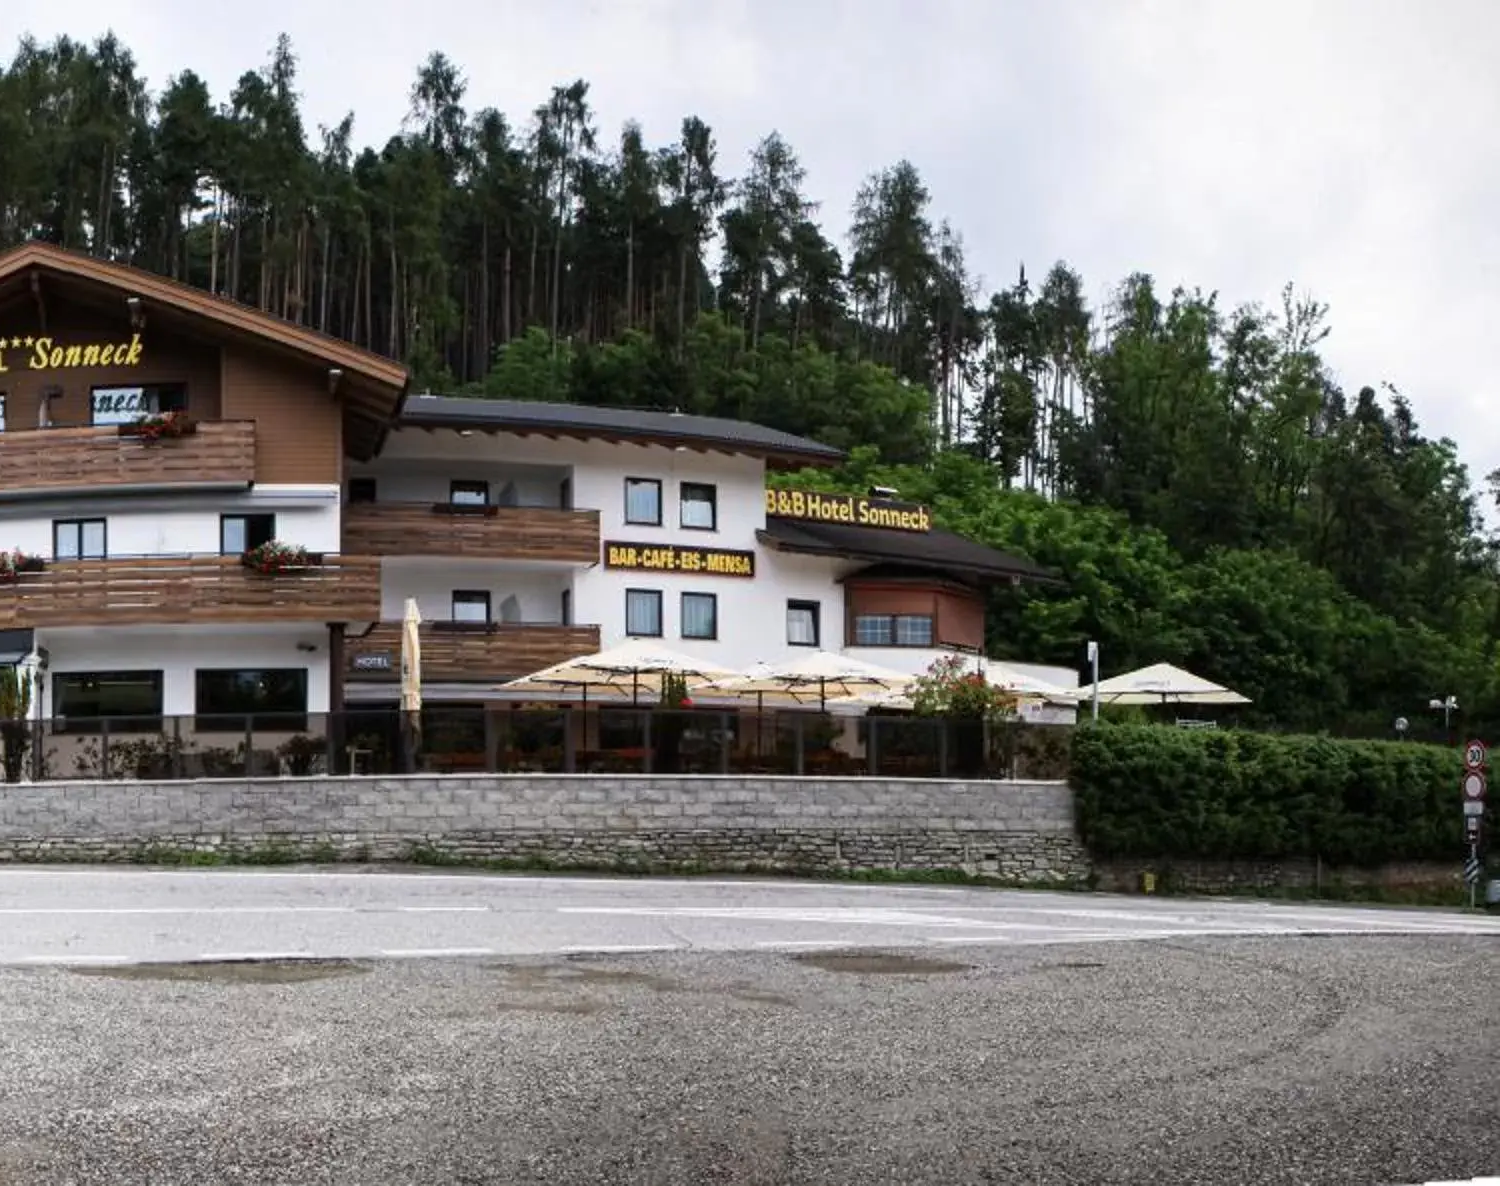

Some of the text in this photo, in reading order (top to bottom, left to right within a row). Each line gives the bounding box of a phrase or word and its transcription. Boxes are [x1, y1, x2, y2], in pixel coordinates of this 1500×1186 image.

[29, 333, 144, 369] Sonneck
[765, 489, 929, 530] B&B Hotel Sonneck
[357, 656, 388, 668] HOTEL
